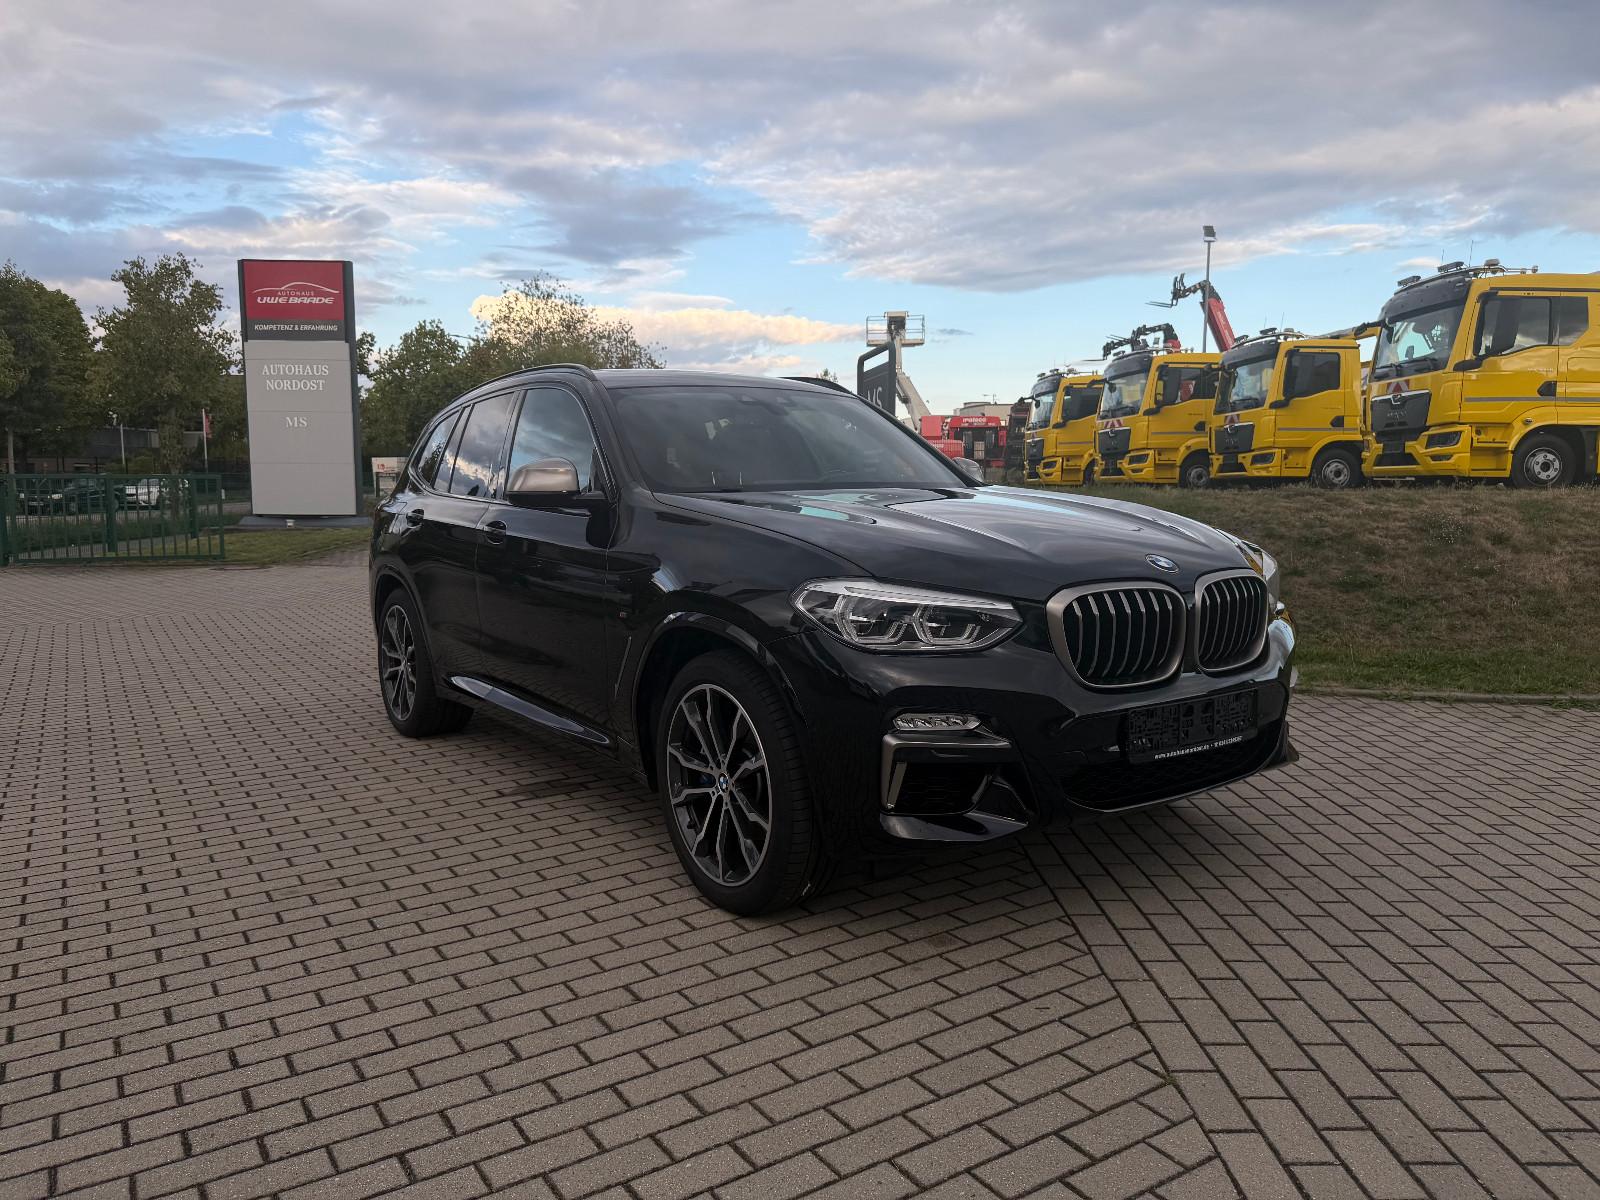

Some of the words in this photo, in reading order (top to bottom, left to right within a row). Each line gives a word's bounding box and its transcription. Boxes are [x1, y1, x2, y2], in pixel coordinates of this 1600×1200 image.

[262, 364, 329, 376] AUTOHAUS
[266, 379, 326, 391] NORDOST
[285, 416, 308, 428] MS
